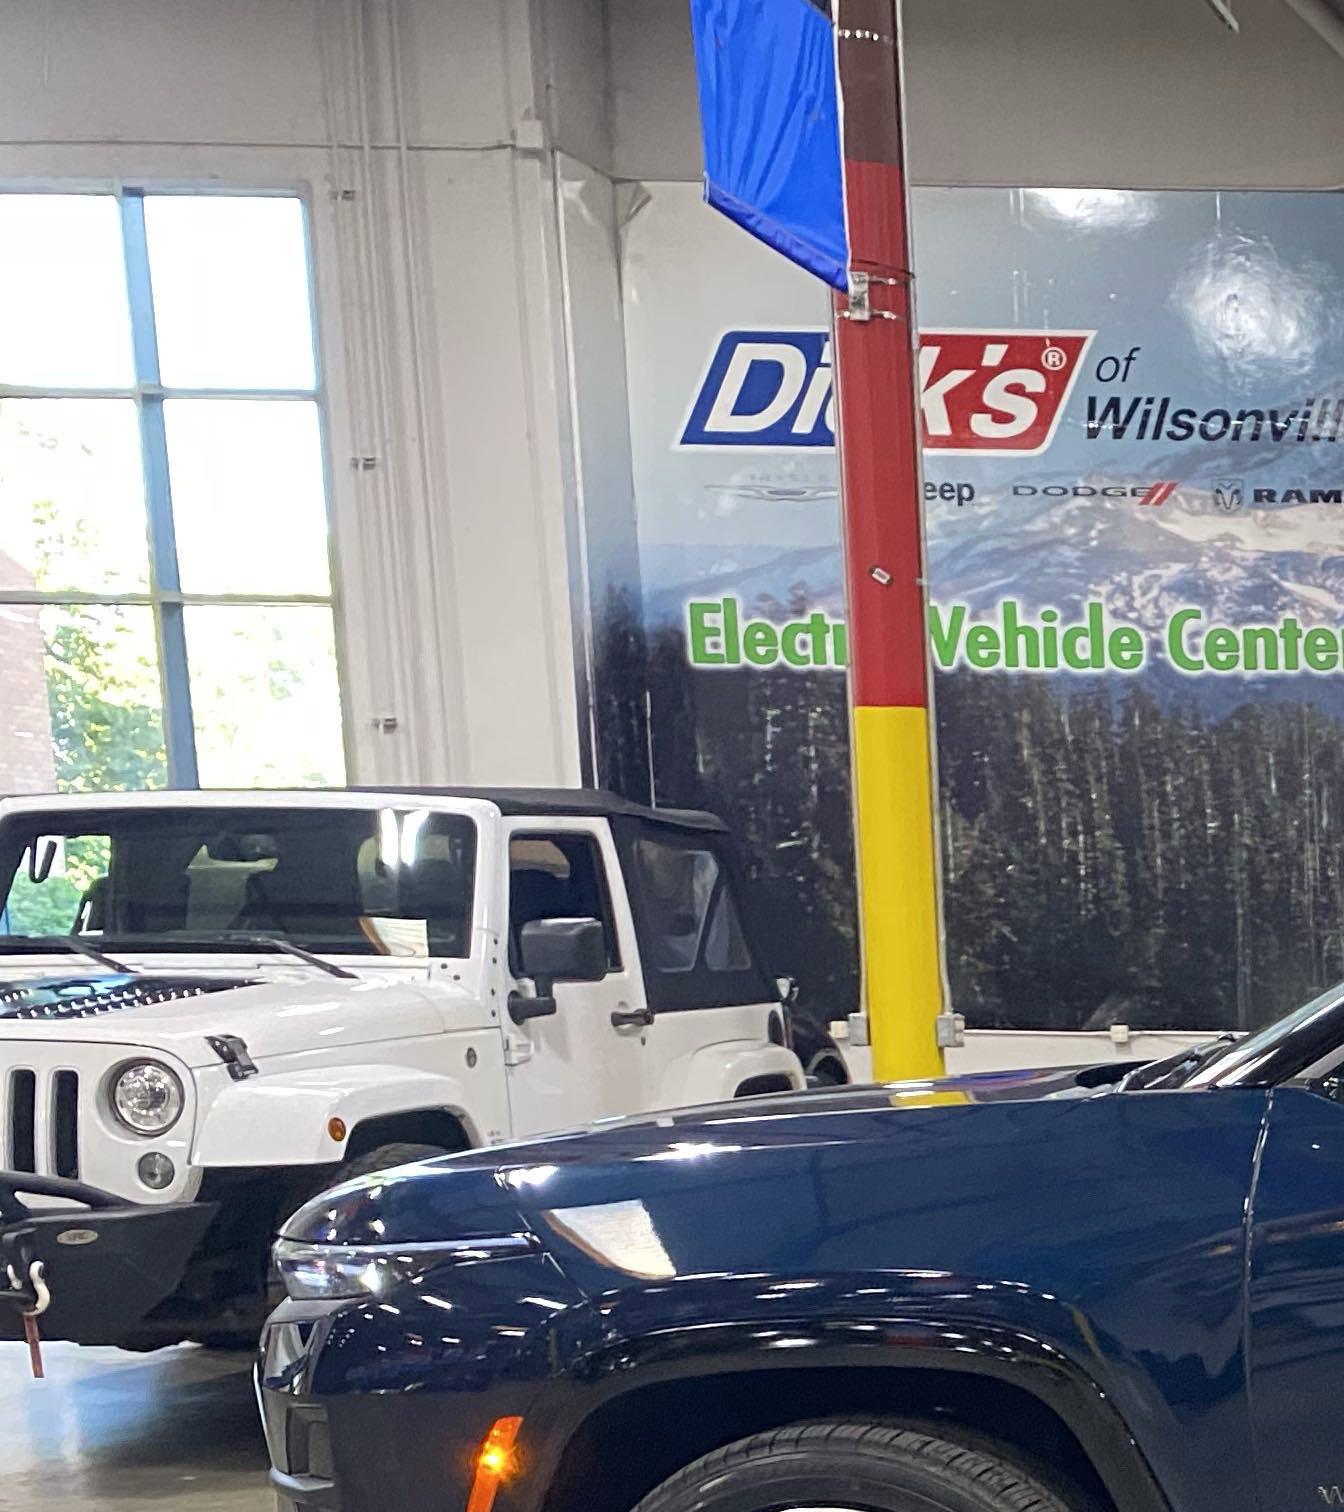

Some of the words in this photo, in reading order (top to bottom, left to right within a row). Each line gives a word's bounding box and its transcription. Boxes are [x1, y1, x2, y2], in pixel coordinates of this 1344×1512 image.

[1095, 347, 1141, 383] of
[924, 481, 975, 506] eep
[1012, 485, 1154, 498] DODGE
[1253, 488, 1343, 504] RAM
[689, 597, 846, 665] Electr
[928, 600, 1144, 669] Vehicle
